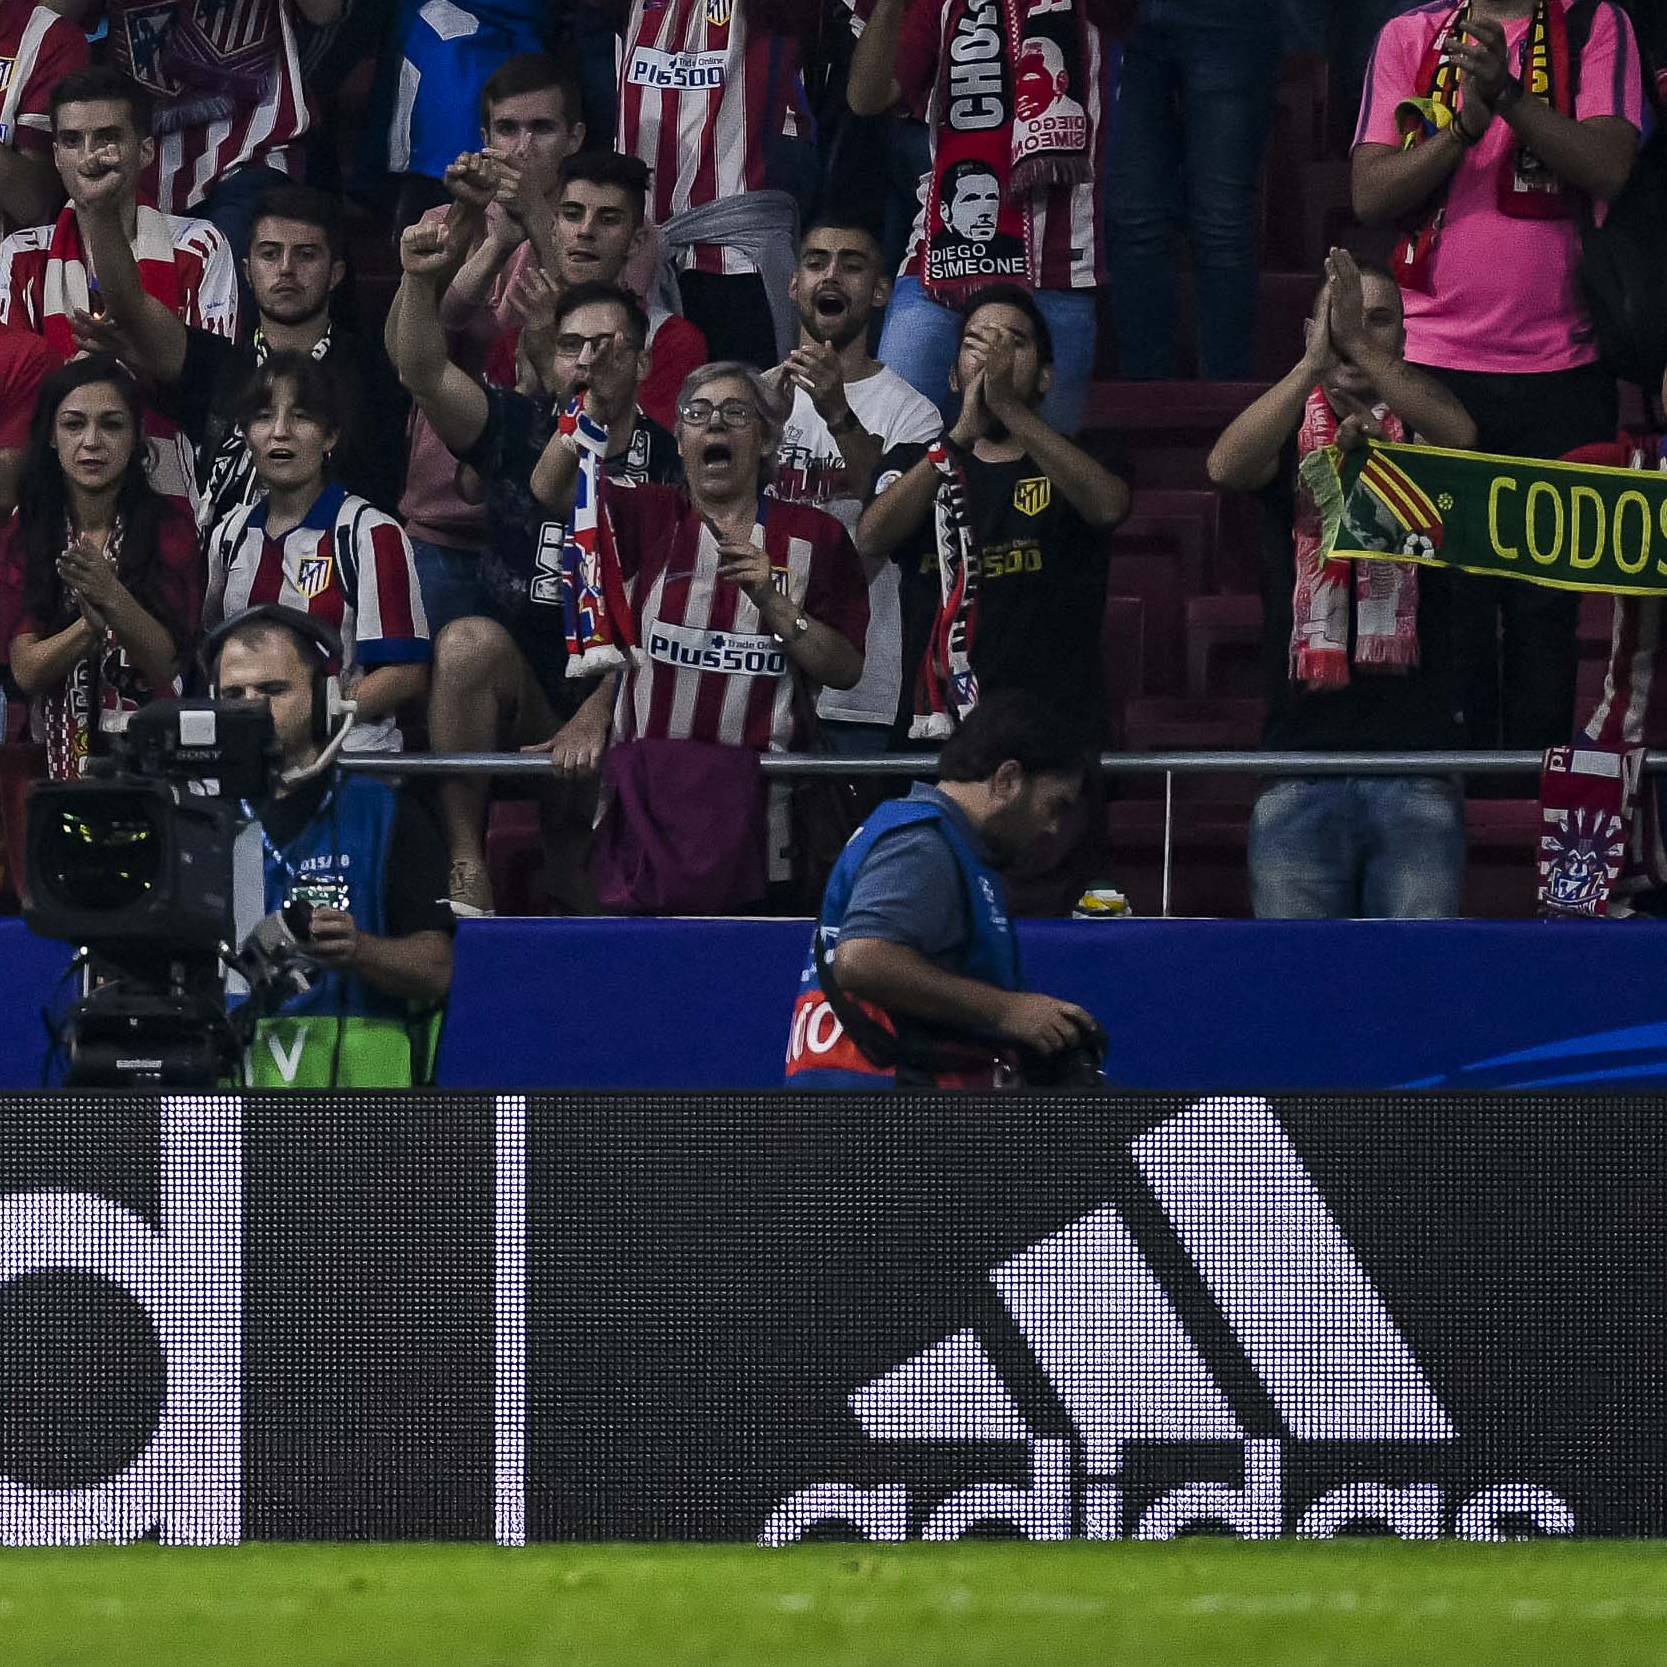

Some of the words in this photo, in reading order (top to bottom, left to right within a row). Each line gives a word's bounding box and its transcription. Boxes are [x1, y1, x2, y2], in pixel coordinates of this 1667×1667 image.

[932, 243, 987, 263] DIEGO
[932, 257, 1025, 281] SIMEONE
[649, 633, 787, 675] Plus500
